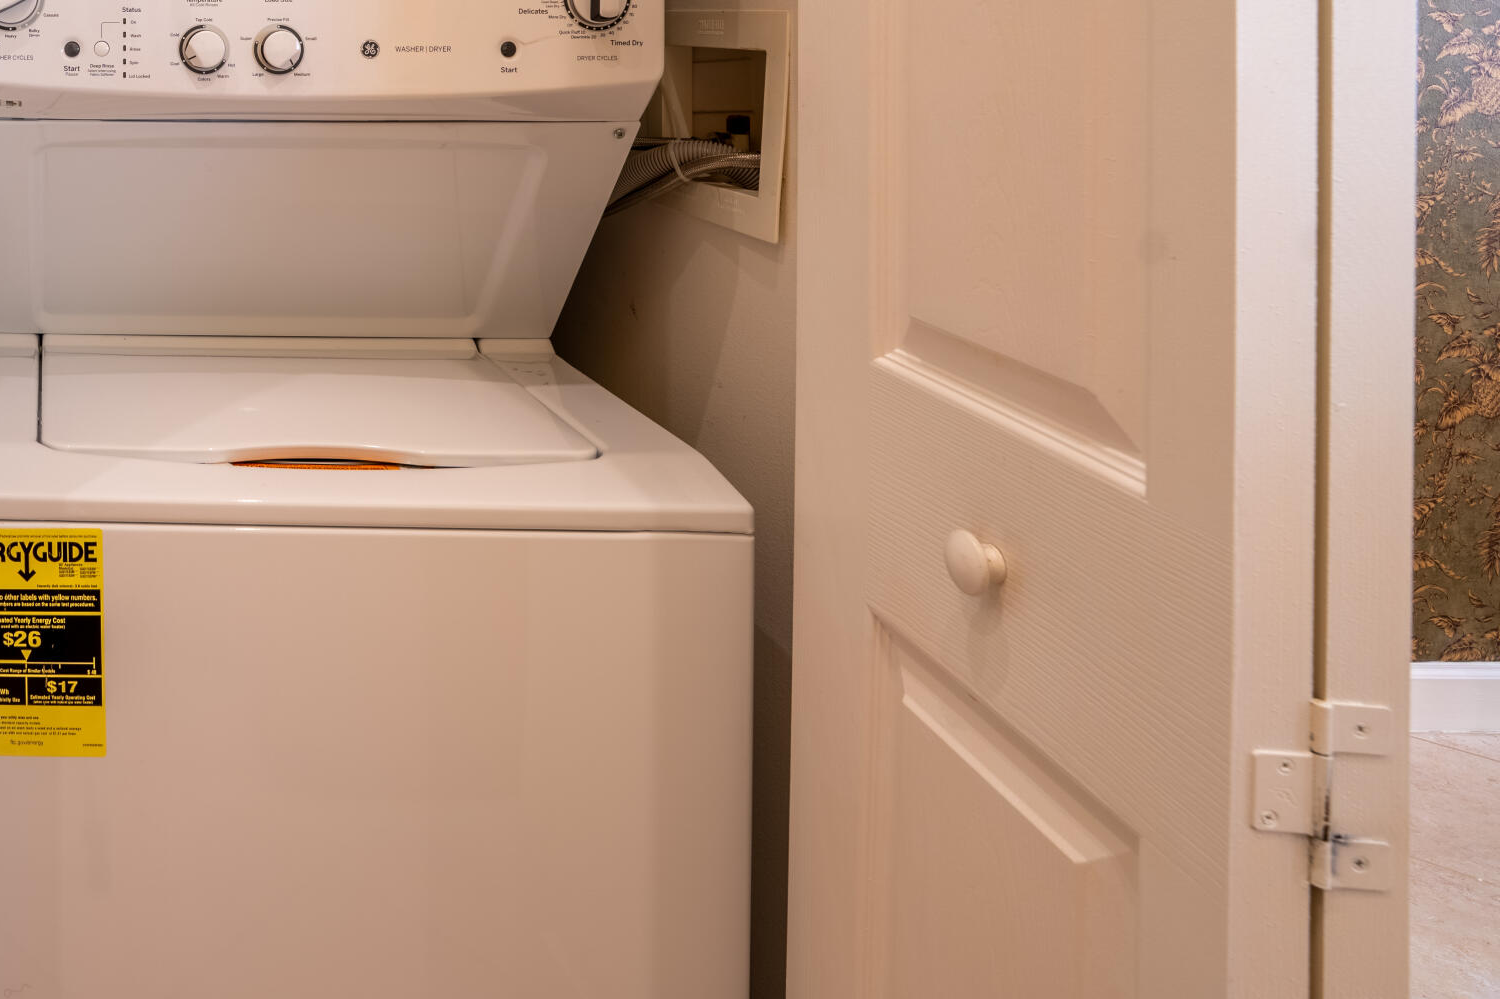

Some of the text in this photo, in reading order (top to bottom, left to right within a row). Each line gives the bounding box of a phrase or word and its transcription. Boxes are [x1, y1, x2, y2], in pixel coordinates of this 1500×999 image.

[518, 7, 549, 15] Delicates
[631, 39, 644, 47] Dry
[395, 45, 425, 53] WASHER
[428, 45, 452, 53] DRYER
[20, 593, 37, 601] labels
[38, 593, 50, 601] with
[51, 593, 70, 602] yellow
[70, 593, 98, 601] numbers.
[13, 616, 31, 625] Yearly
[31, 616, 52, 625] Energy
[52, 616, 66, 624] Cost
[2, 630, 42, 648] $26
[46, 680, 78, 694] $17
